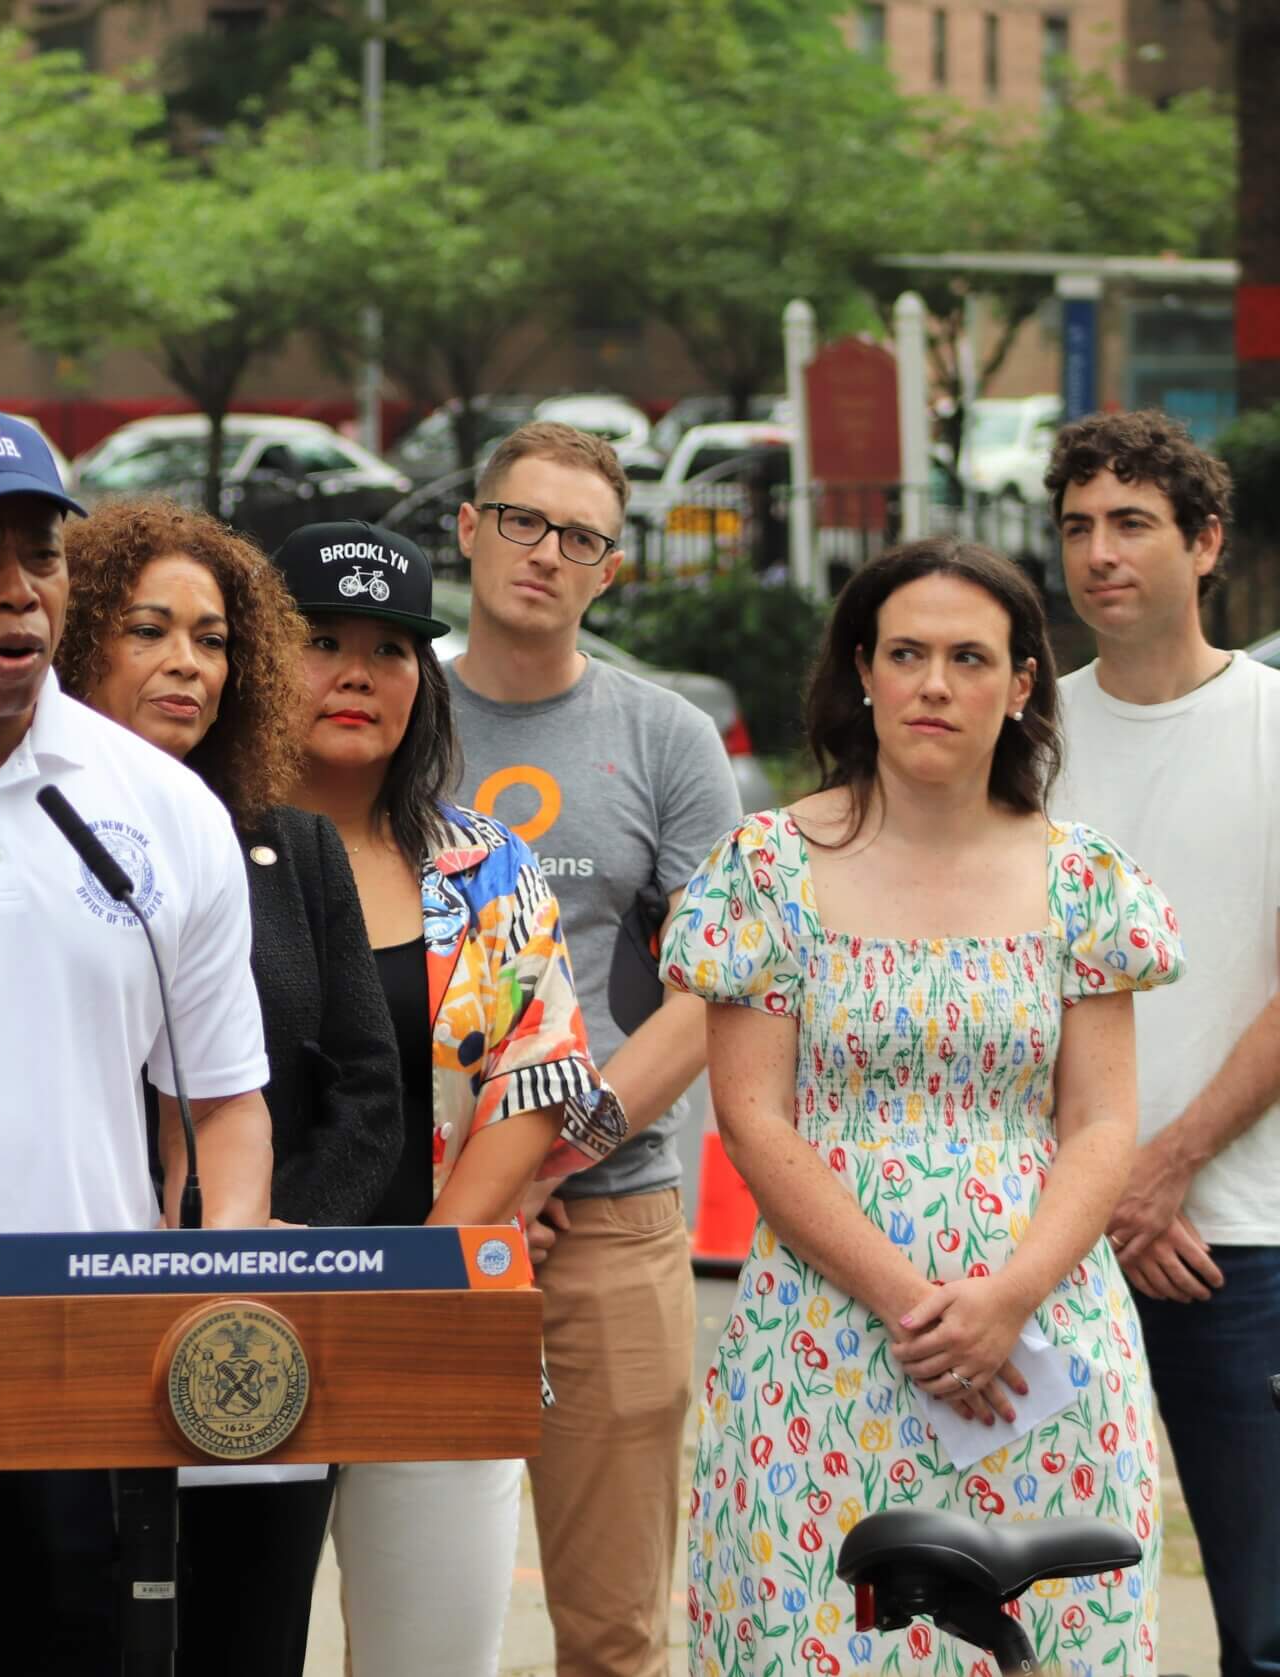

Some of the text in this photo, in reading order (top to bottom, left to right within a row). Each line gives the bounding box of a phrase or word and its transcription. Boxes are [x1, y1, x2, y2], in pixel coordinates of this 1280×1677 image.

[320, 542, 409, 574] BROOKLYN
[100, 819, 124, 832] NEW
[125, 824, 150, 848] YORK
[75, 886, 106, 919] OFFICE
[106, 911, 119, 925] OF
[121, 914, 140, 928] THE
[68, 1249, 384, 1277] HEARFROMERIC.COM
[225, 1423, 251, 1433] 1625
